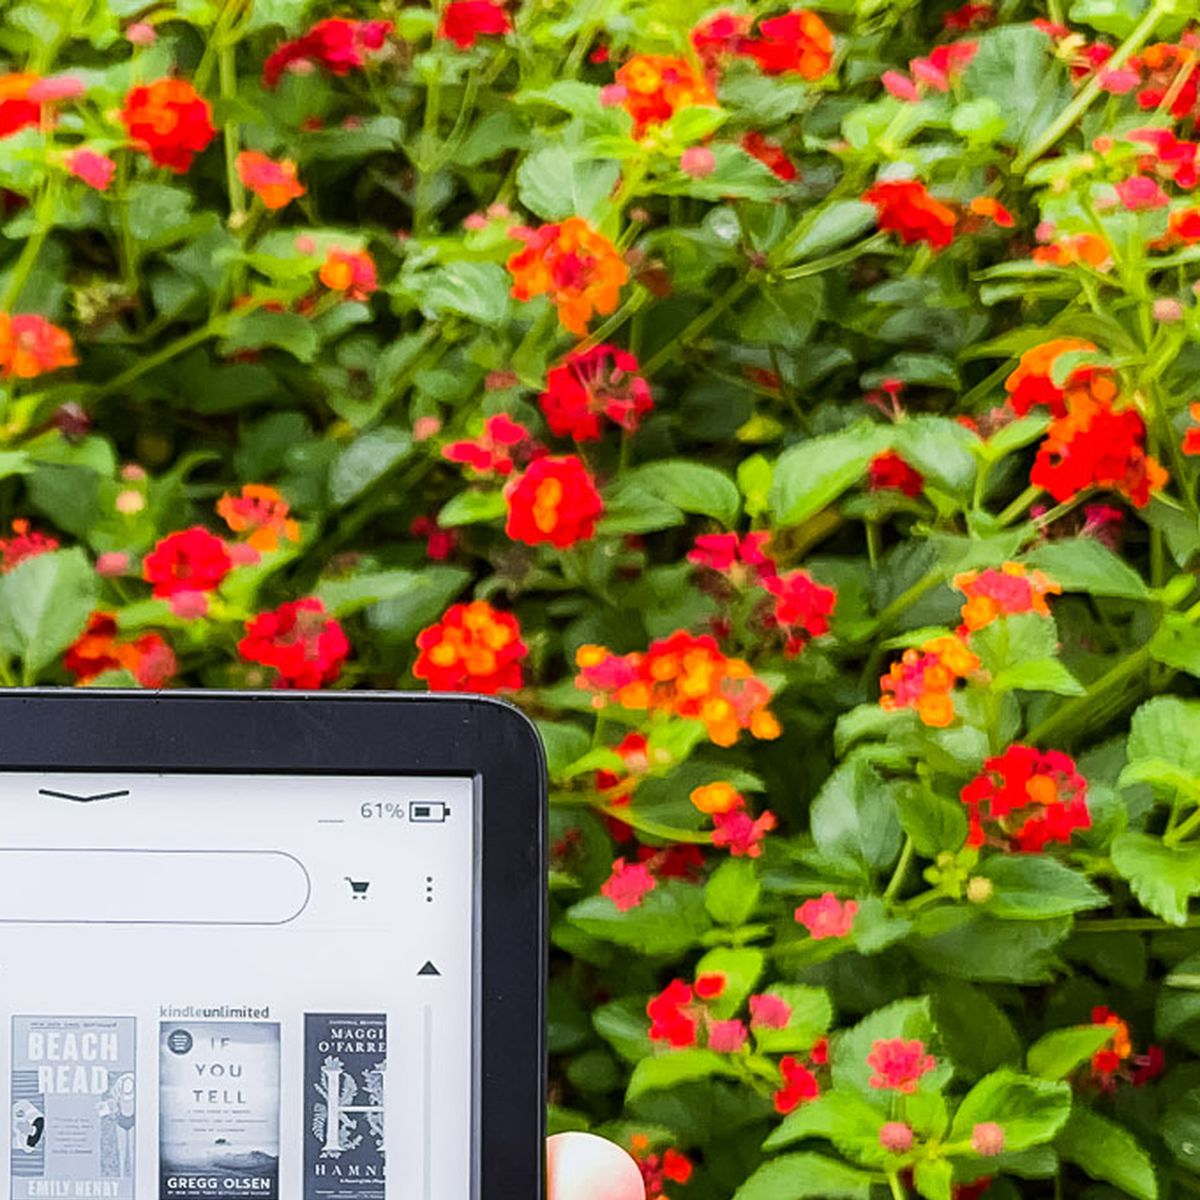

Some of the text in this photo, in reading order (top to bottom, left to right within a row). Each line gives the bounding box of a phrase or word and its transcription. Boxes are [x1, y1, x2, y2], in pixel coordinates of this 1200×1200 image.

[360, 802, 405, 820] 61%
[159, 1006, 270, 1019] kindleunlimited
[28, 1031, 119, 1062] BEACH
[210, 1036, 231, 1050] IF
[195, 1063, 242, 1078] YOU
[37, 1065, 110, 1095] READ
[192, 1089, 247, 1105] TELL
[28, 1180, 71, 1197] EMILY
[167, 1177, 271, 1190] GREGG OLSEN
